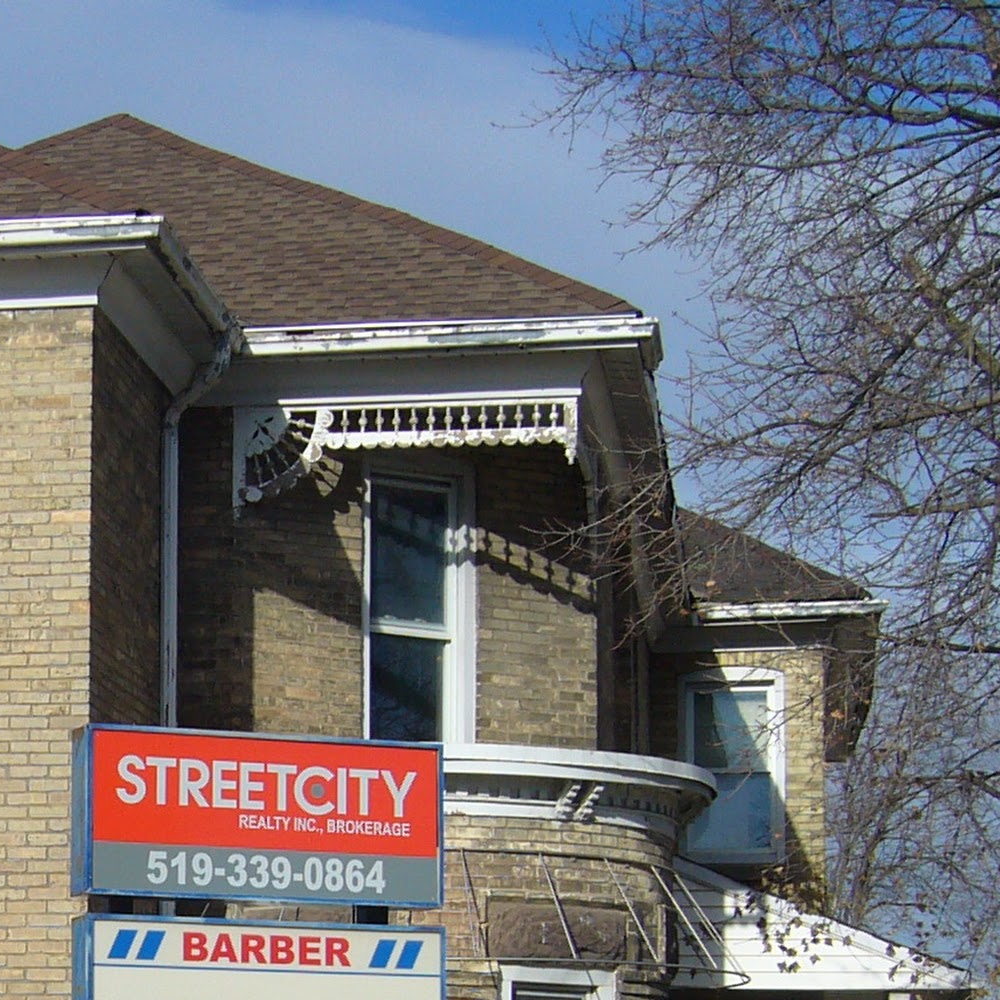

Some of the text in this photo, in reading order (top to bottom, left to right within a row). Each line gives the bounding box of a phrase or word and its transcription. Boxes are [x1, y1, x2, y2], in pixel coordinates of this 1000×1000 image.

[115, 755, 417, 818] STREETCITY
[238, 814, 290, 831] REALTY
[327, 819, 411, 837] BROKERAGE
[146, 850, 386, 894] 519-339-0864
[182, 931, 351, 967] BARBER
